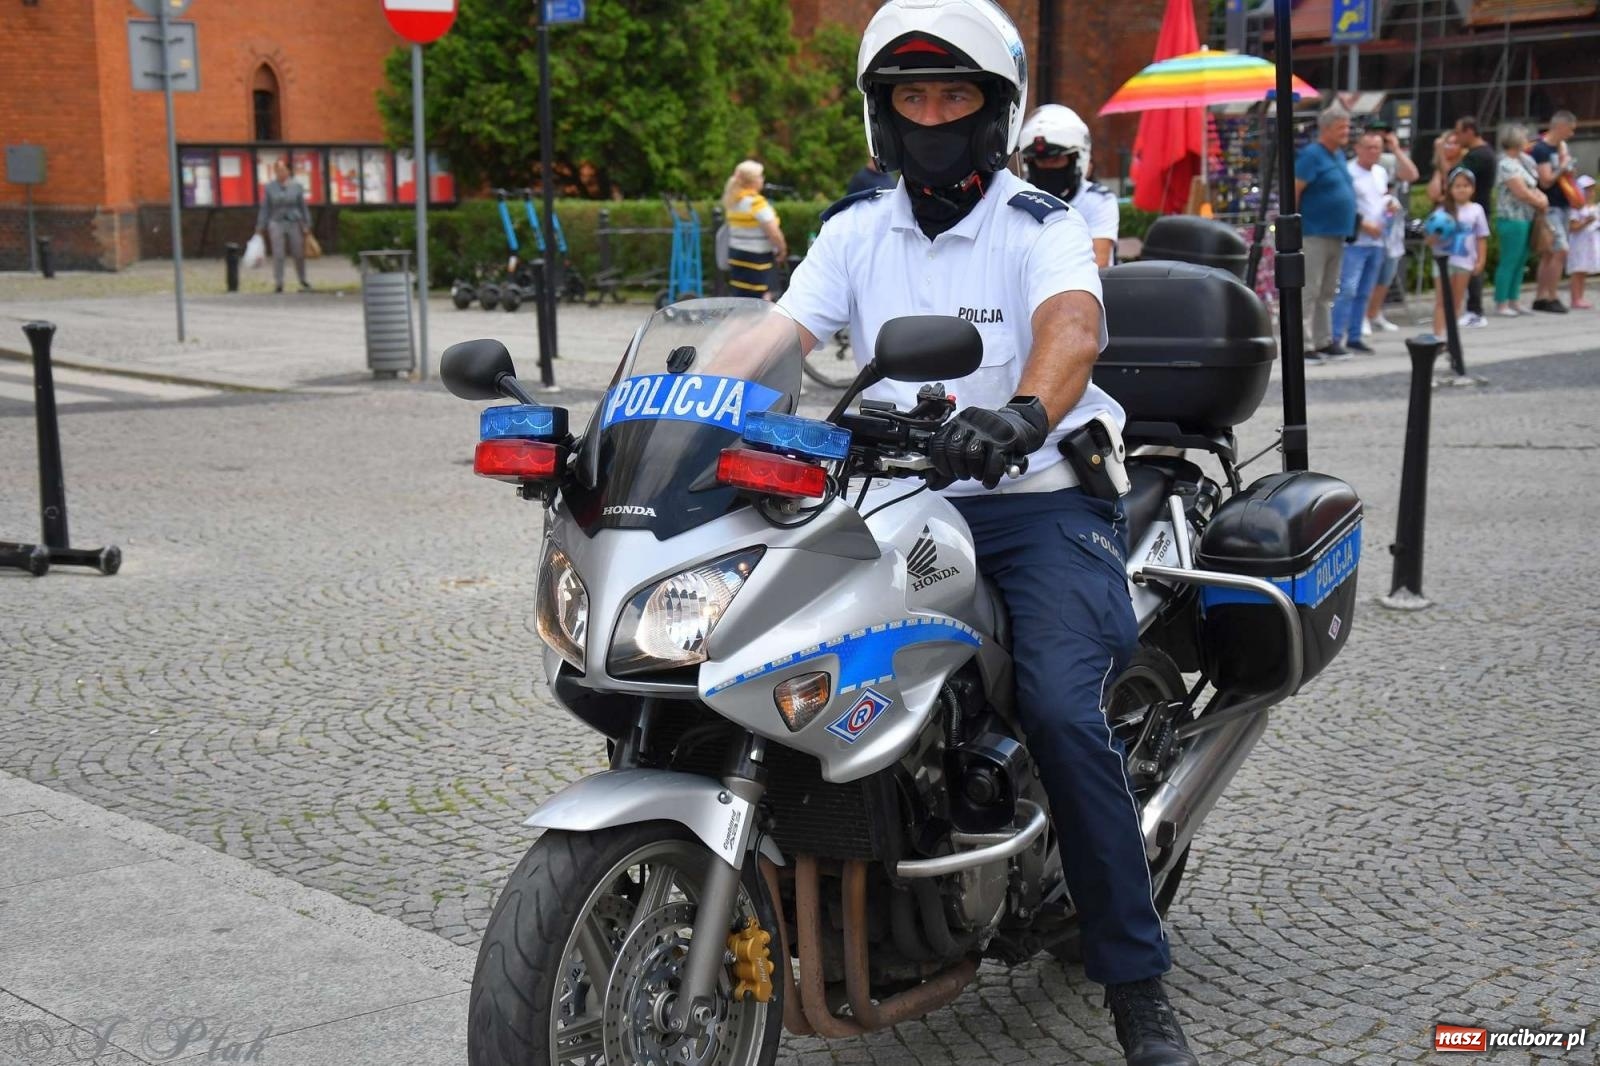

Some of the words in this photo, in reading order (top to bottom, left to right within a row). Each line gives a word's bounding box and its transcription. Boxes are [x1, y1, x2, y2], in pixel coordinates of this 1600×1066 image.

[606, 376, 745, 426] POLICJA
[603, 505, 656, 518] HONDA
[1157, 539, 1172, 562] 1000
[911, 566, 960, 592] HONDA
[1316, 540, 1353, 595] POLICJA
[853, 707, 869, 726] R
